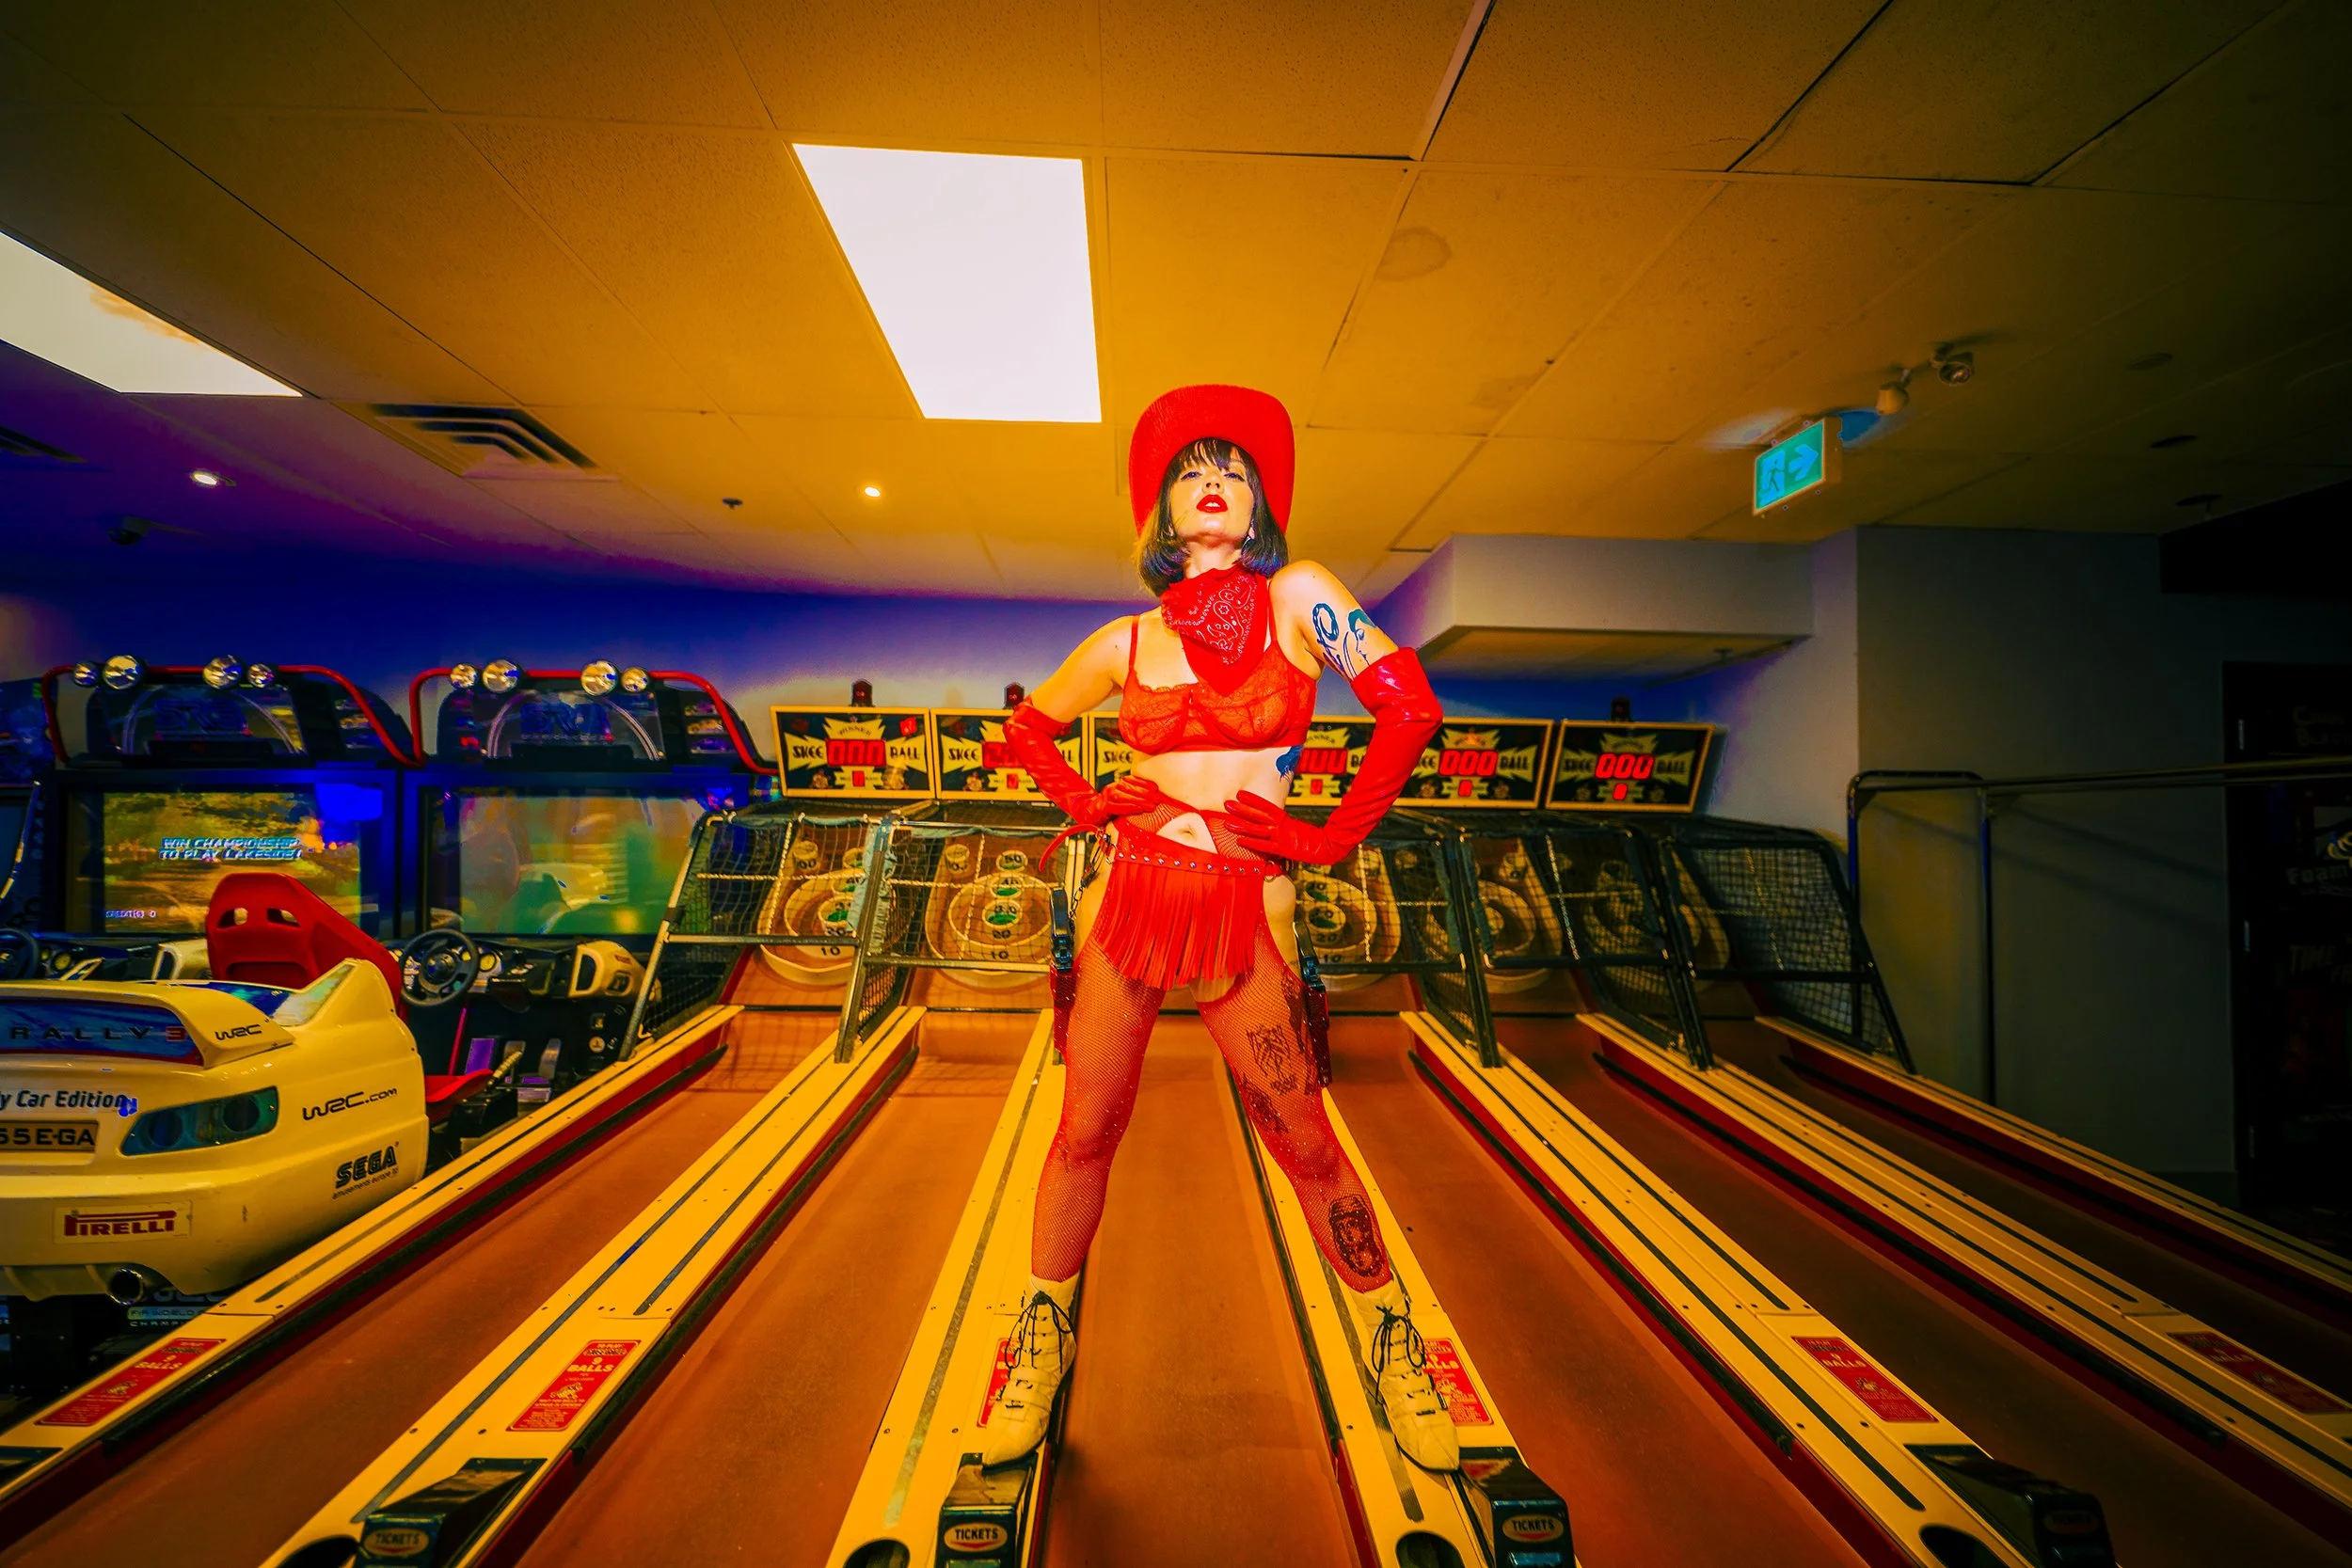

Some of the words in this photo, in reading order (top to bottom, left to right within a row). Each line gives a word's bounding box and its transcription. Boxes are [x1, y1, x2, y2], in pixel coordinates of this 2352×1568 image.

[793, 745, 823, 758] SKEE
[948, 748, 978, 761] SKEE
[1439, 750, 1498, 776] 000
[1595, 753, 1654, 780] 000
[162, 837, 191, 848] WIN
[9, 1025, 153, 1041] RALLY
[166, 1026, 188, 1041] 3
[215, 1023, 262, 1040] WRC
[16, 1090, 51, 1108] Car
[55, 1089, 128, 1108] Edition
[336, 1145, 398, 1189] SEGA
[64, 1210, 177, 1237] PIRELLI
[566, 1364, 614, 1372] BALLS
[375, 1532, 420, 1545] TICKETS
[954, 1528, 999, 1541] TICKETS
